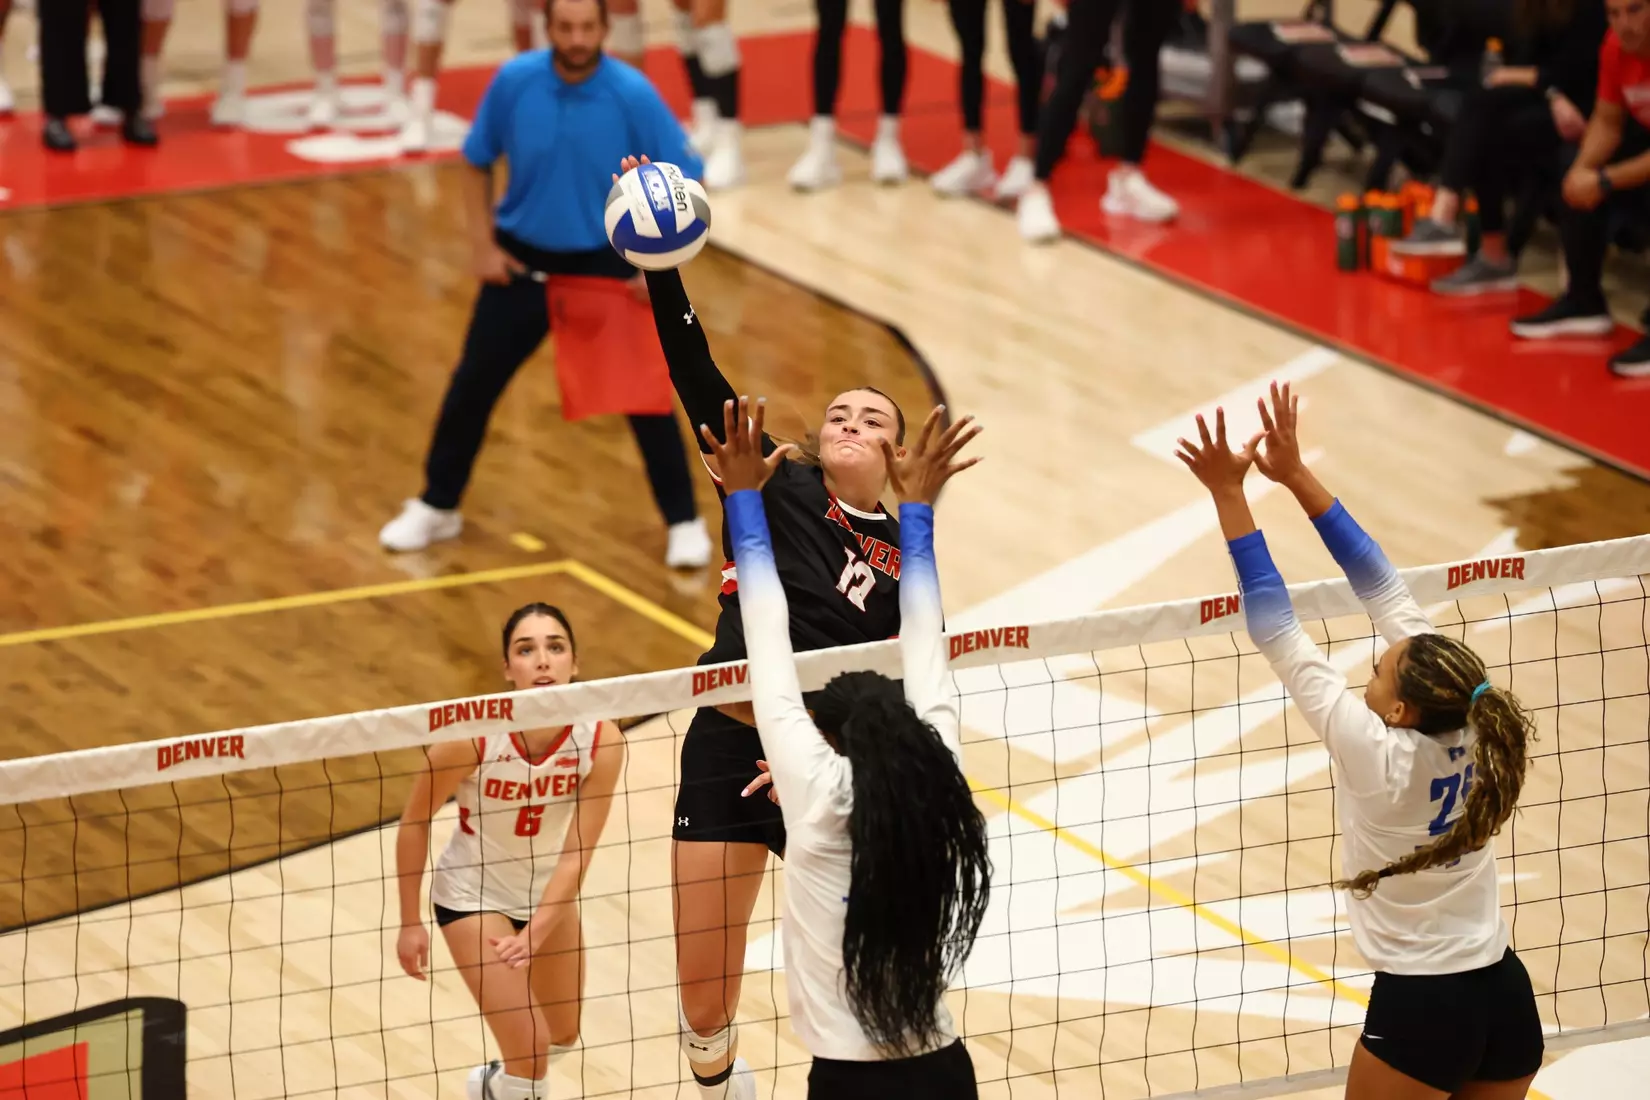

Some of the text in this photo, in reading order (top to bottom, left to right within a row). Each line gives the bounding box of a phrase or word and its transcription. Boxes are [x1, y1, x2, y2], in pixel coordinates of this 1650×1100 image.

[1446, 557, 1525, 591] DENVER
[1200, 594, 1240, 626] DEN
[949, 625, 1030, 661] DENVER
[692, 663, 750, 697] DENV
[429, 698, 514, 733] DENVER
[157, 735, 245, 772] DENVER
[515, 805, 545, 837] 6
